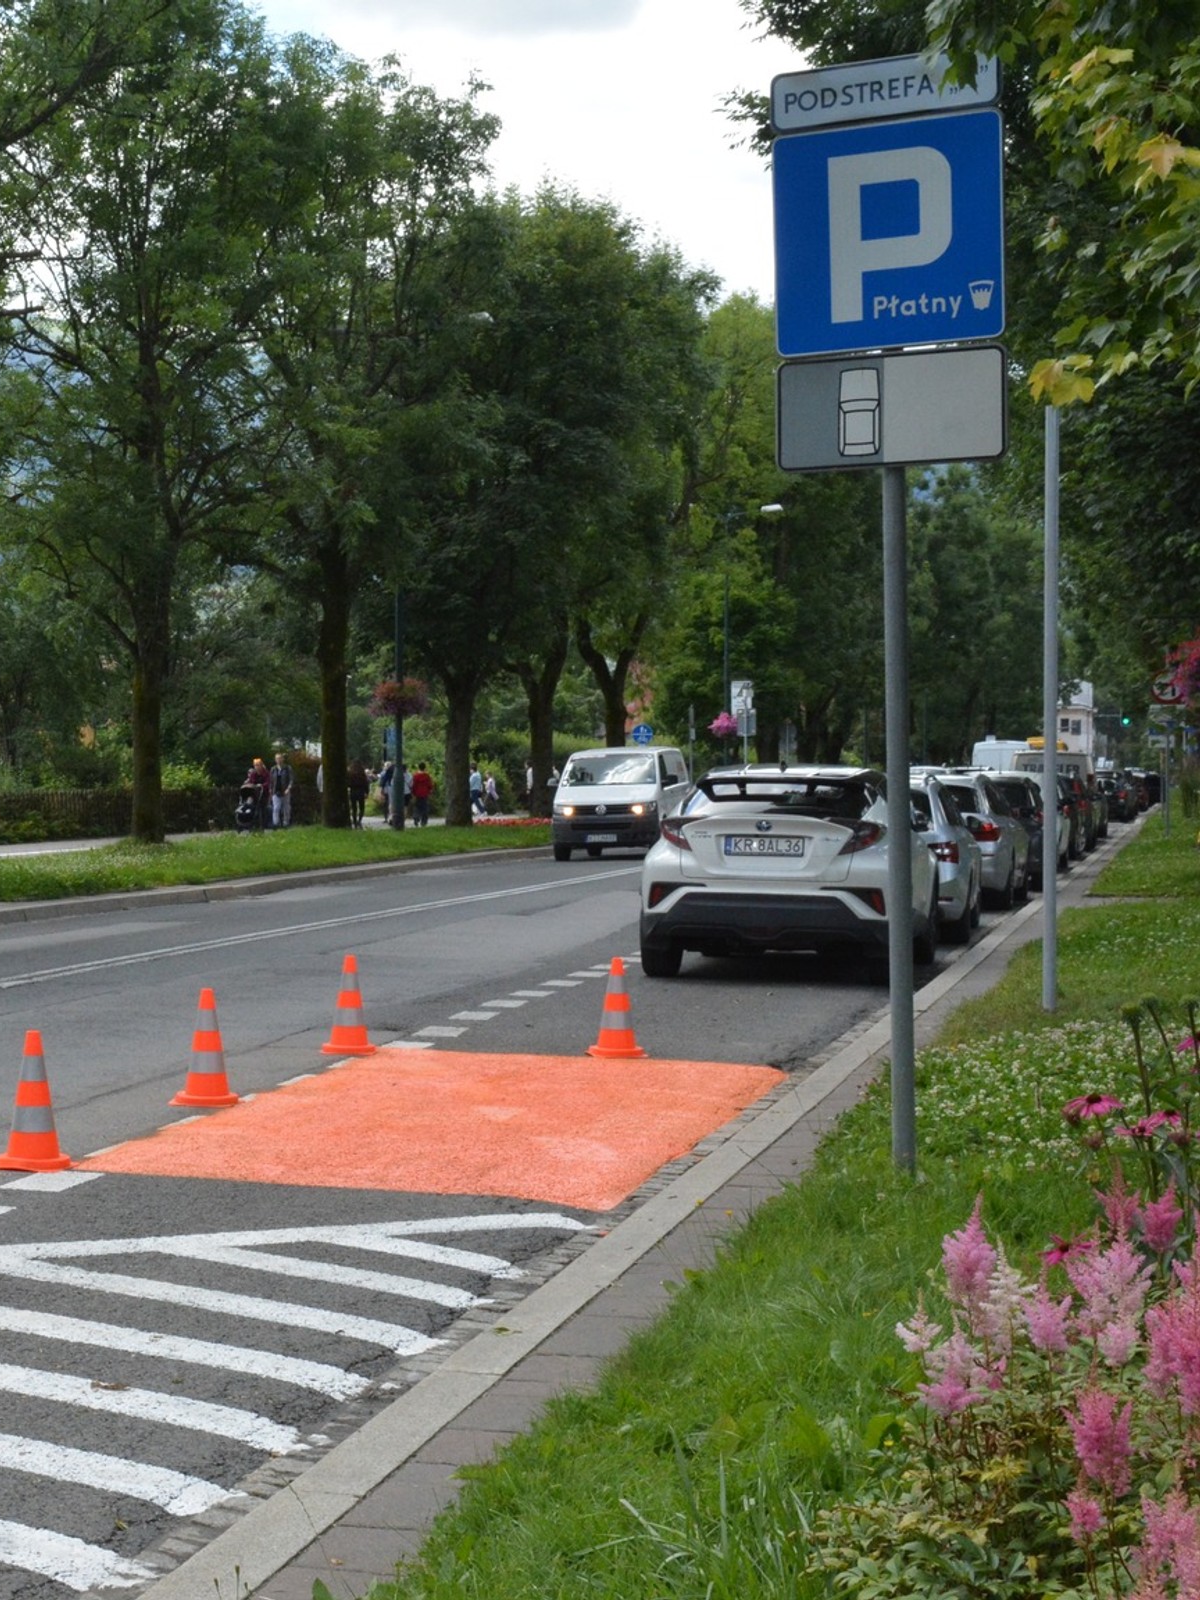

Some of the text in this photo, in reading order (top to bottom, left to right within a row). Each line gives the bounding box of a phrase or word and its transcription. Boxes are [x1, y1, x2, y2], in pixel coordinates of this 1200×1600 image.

[784, 74, 934, 114] PODSTREFA
[827, 145, 953, 324] P
[873, 292, 963, 319] Płatny
[733, 838, 801, 853] KR 8AL36
